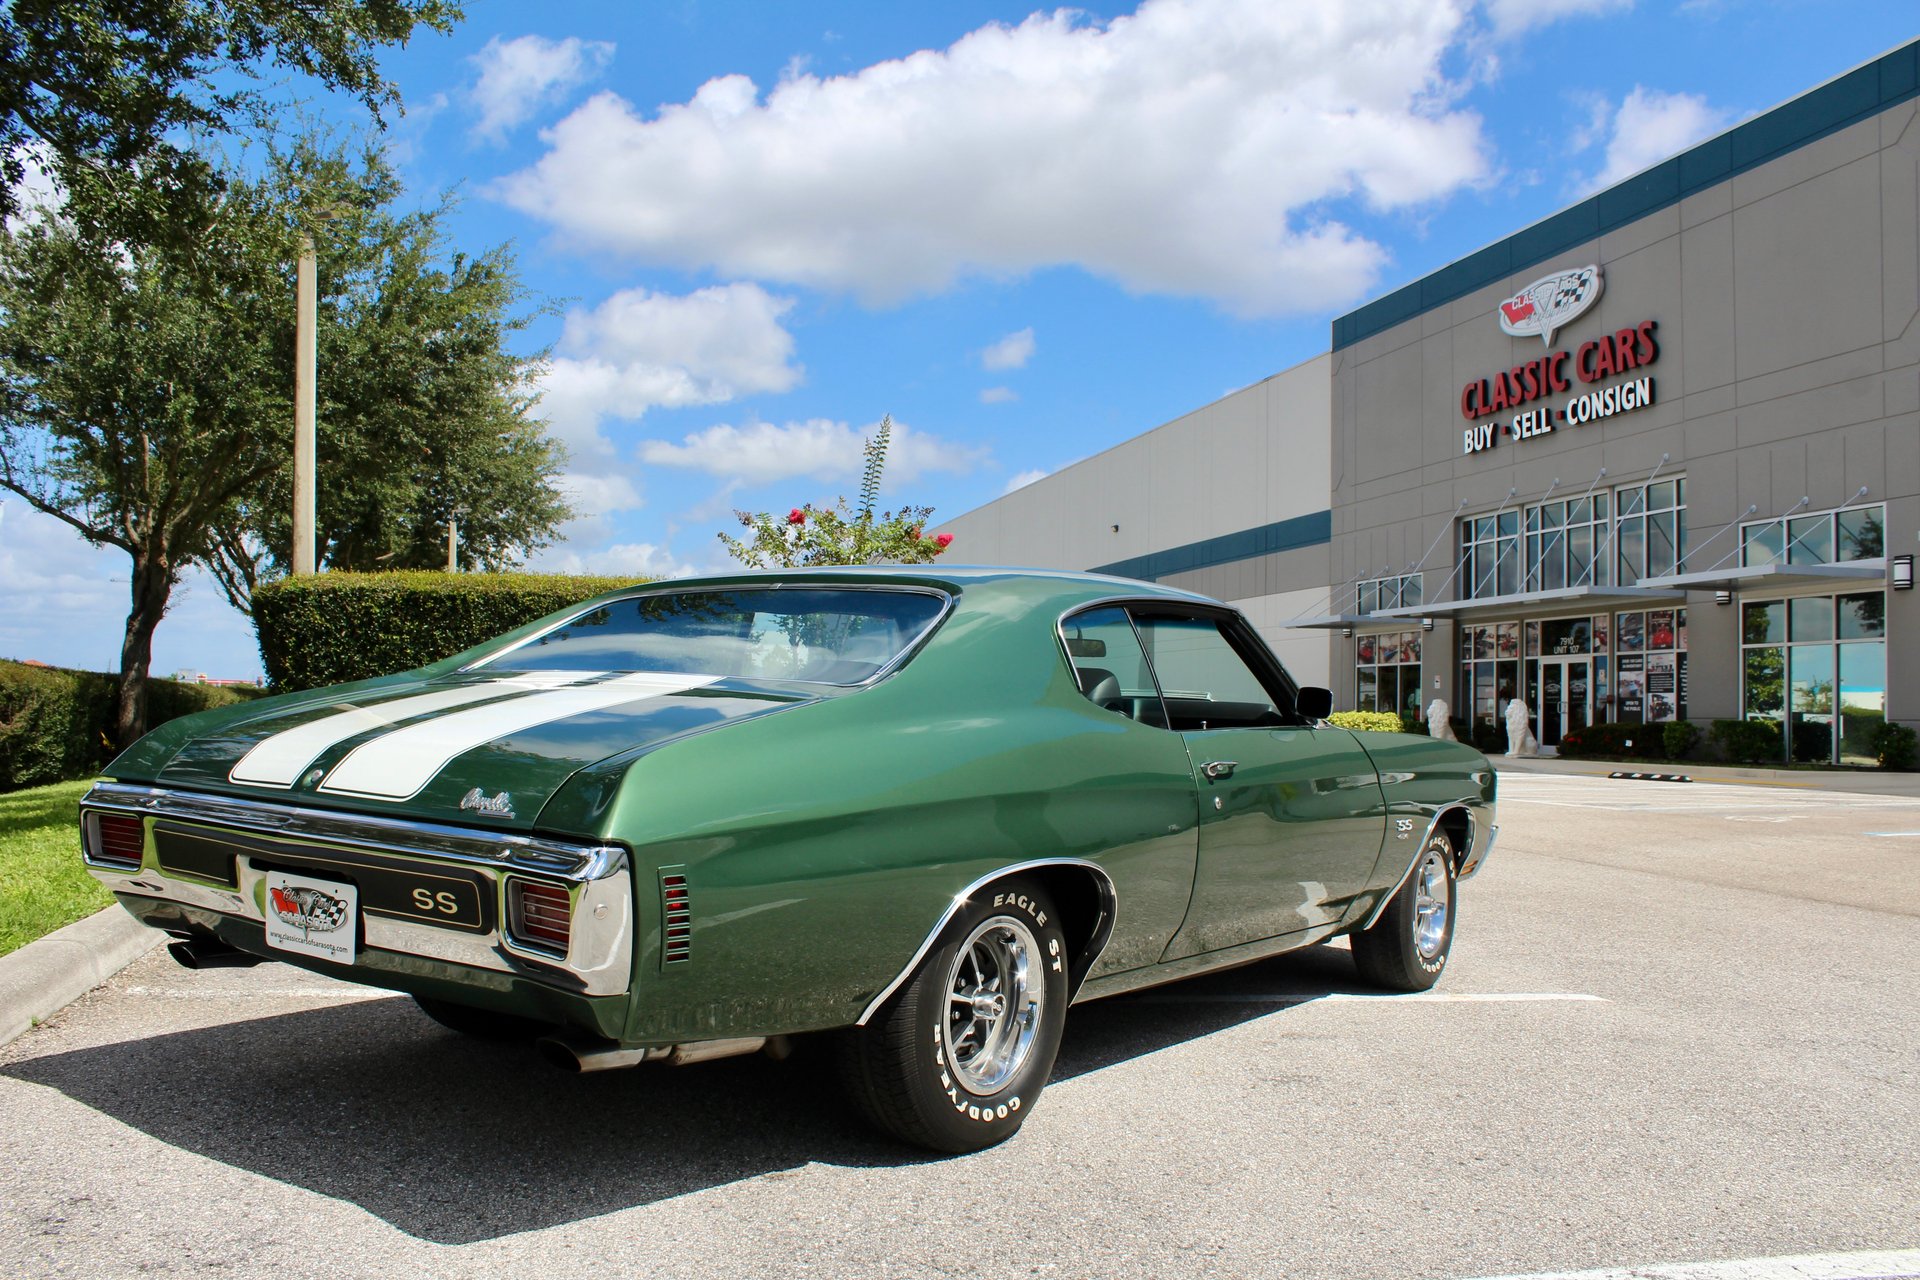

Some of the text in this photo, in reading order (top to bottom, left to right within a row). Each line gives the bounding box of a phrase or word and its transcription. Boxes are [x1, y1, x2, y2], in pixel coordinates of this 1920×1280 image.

[1461, 320, 1657, 420] CLASSIC CARS
[1464, 376, 1651, 454] BUY SELL CONSIGN
[1553, 645, 1580, 655] UNIT 107
[1396, 818, 1413, 831] SS
[412, 888, 459, 914] SS
[279, 910, 334, 933] SARASOTA
[993, 892, 1062, 973] EAGLE ST
